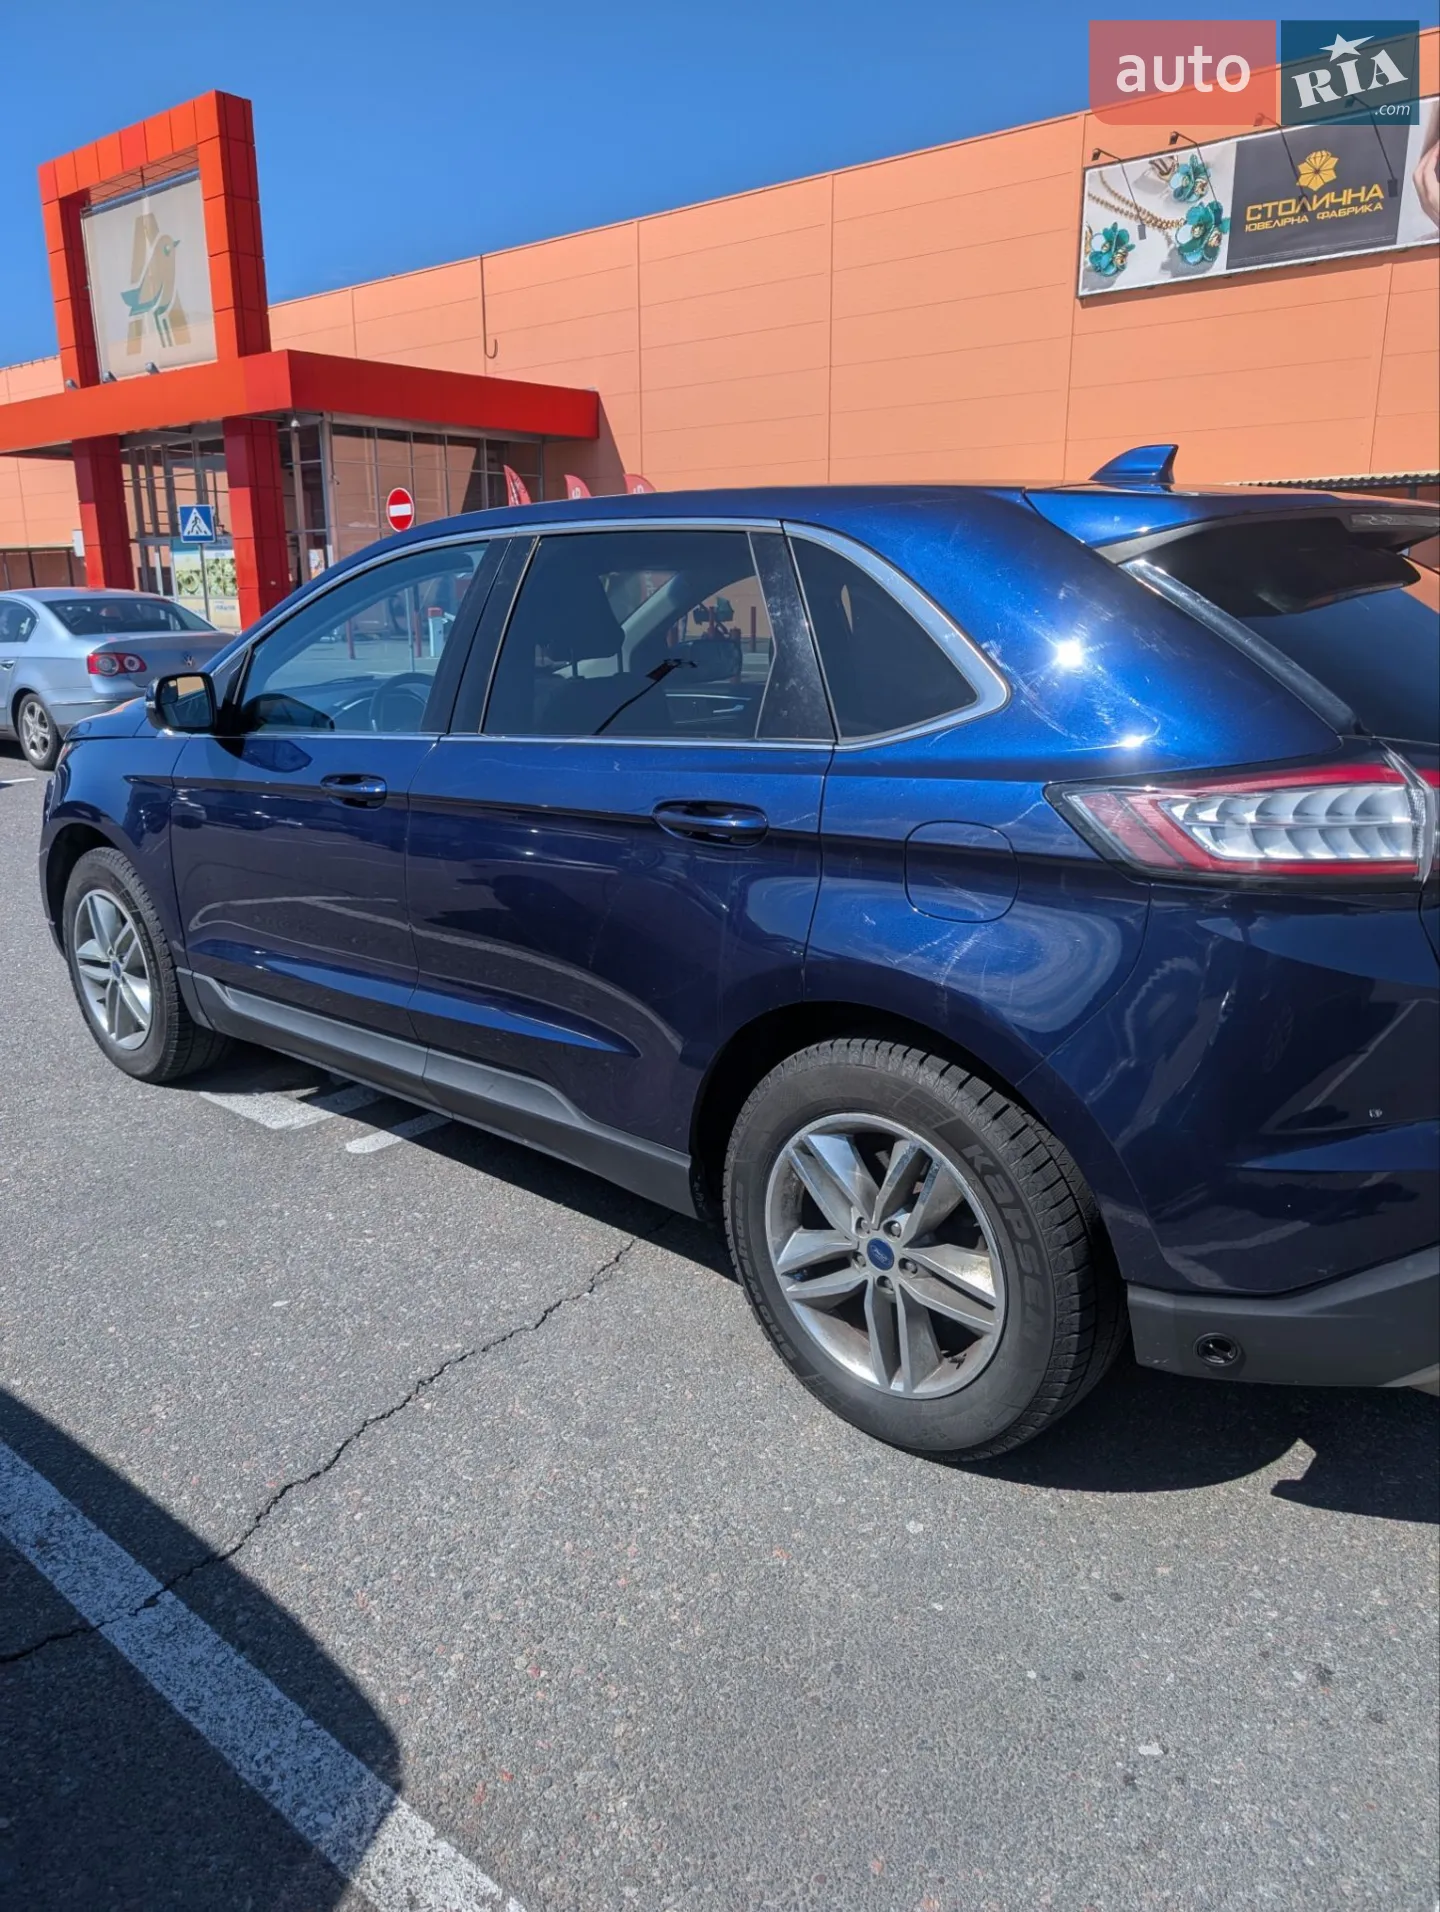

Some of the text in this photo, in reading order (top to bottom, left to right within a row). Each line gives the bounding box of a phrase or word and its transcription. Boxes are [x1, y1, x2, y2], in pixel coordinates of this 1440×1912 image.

[1244, 202, 1383, 232] ЮВЕЛІРНА ФАБРИКА
[1246, 183, 1385, 221] СТОЛИЧНА
